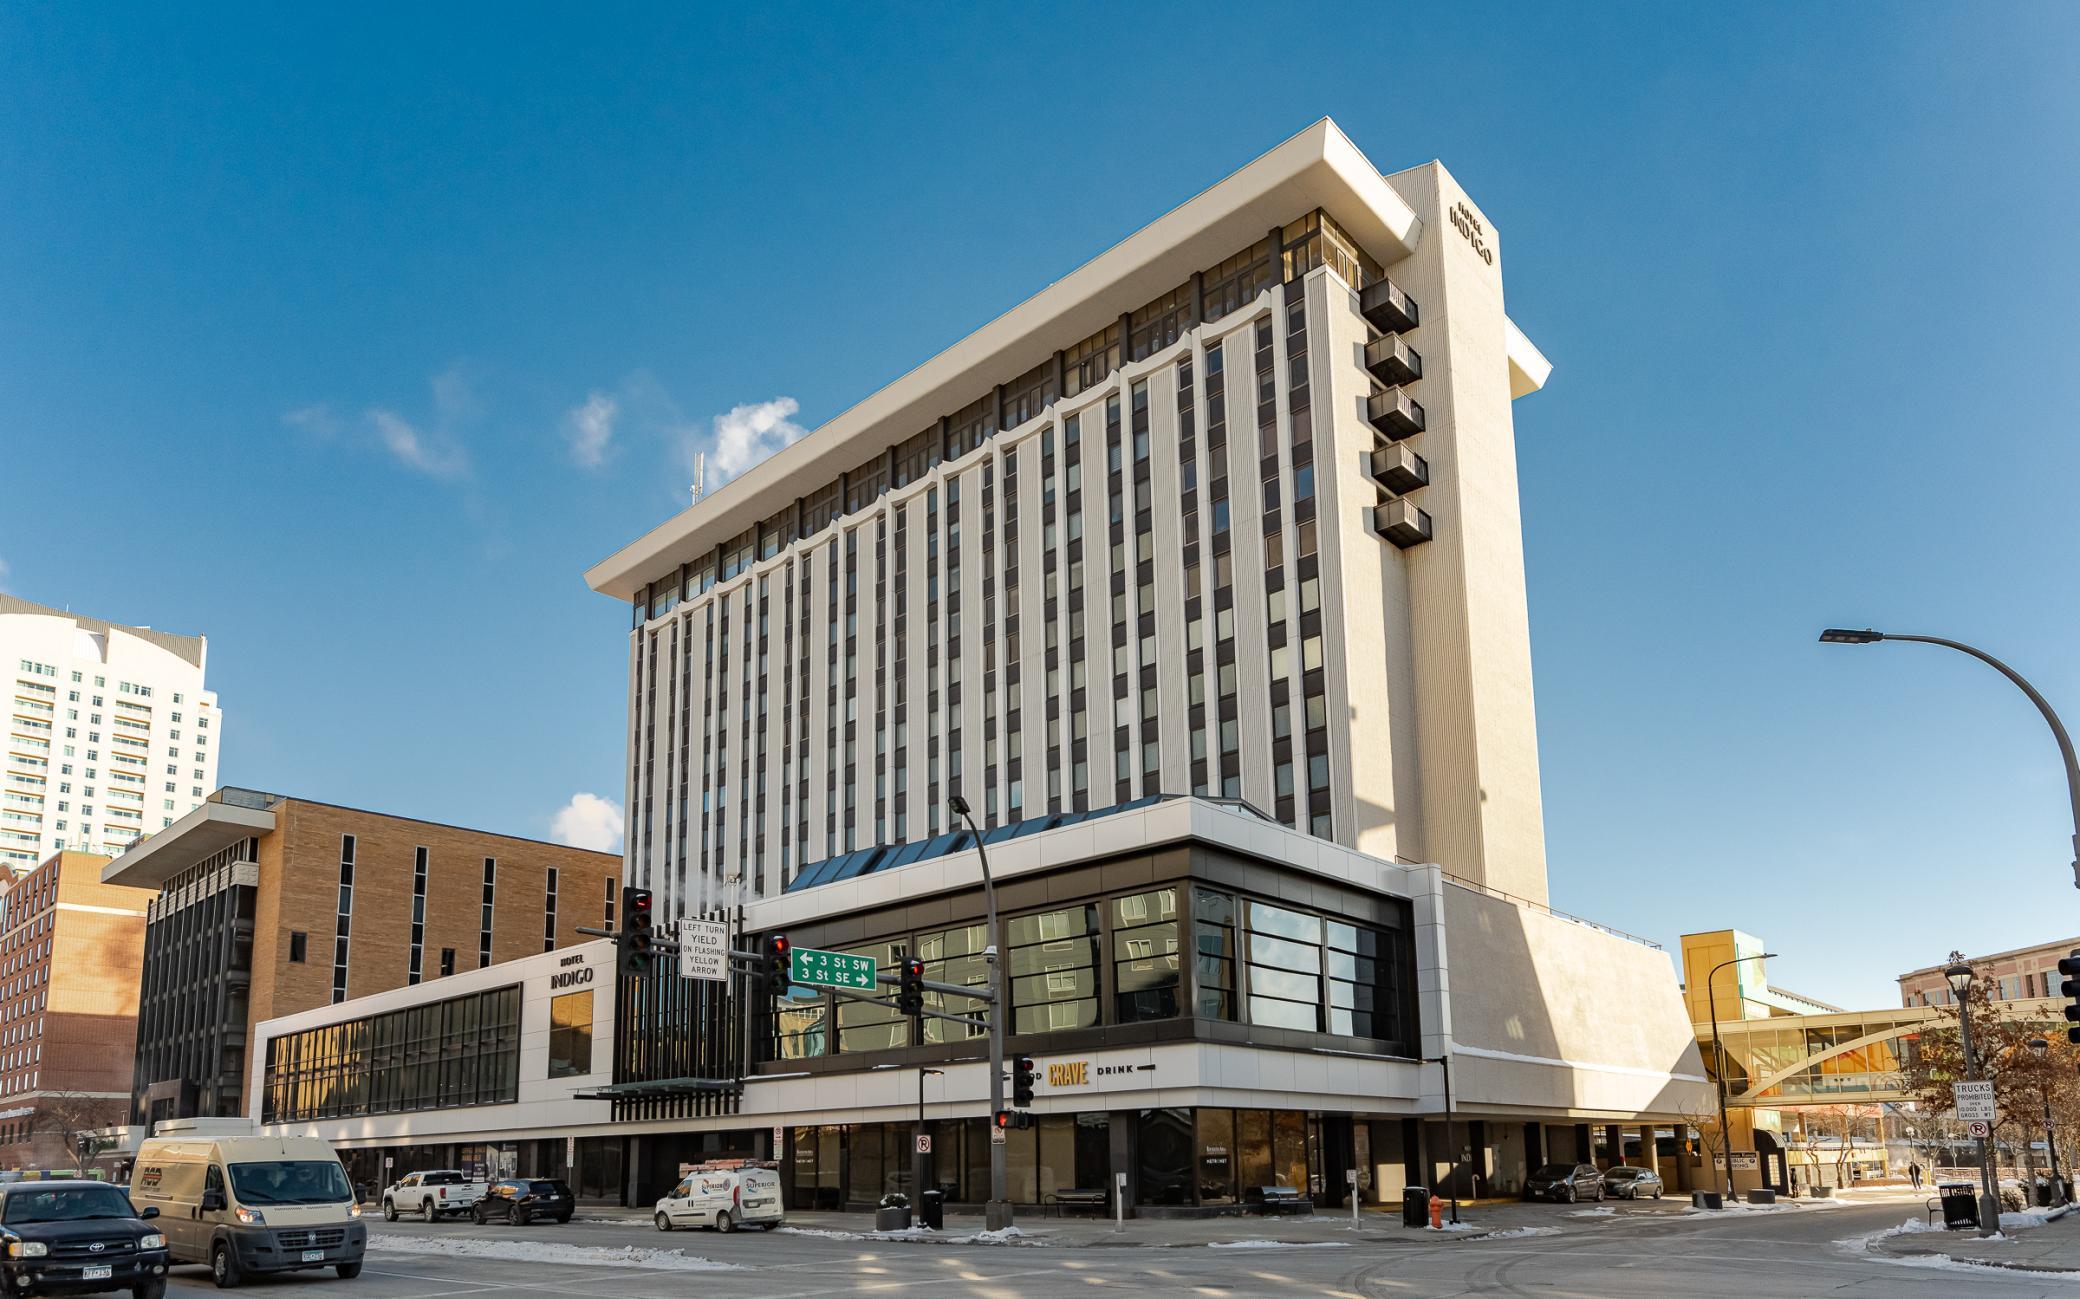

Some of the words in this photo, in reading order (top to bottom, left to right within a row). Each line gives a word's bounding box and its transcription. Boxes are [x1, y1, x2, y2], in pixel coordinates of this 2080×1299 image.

[1458, 201, 1482, 236] HOTEL
[1449, 206, 1492, 266] INDIGO
[683, 922, 701, 932] LEFT
[705, 925, 725, 935] TURN
[691, 934, 718, 945] YIELD
[683, 945, 692, 953] ON
[694, 946, 725, 957] FLASHING
[560, 954, 585, 968] HOTEL
[689, 955, 719, 966] YELLOW
[820, 955, 828, 967] 3
[833, 957, 847, 969] St
[852, 959, 869, 972] SW
[691, 965, 718, 976] ARROW
[802, 968, 810, 979] 3
[816, 969, 829, 981] St
[835, 971, 851, 984] SE
[551, 967, 594, 990] INDIGO
[1048, 1060, 1089, 1087] CRAVE
[1097, 1064, 1134, 1076] DRINK
[1956, 1083, 1991, 1093] TRUCKS
[1957, 1093, 1992, 1101] PROHIBITED
